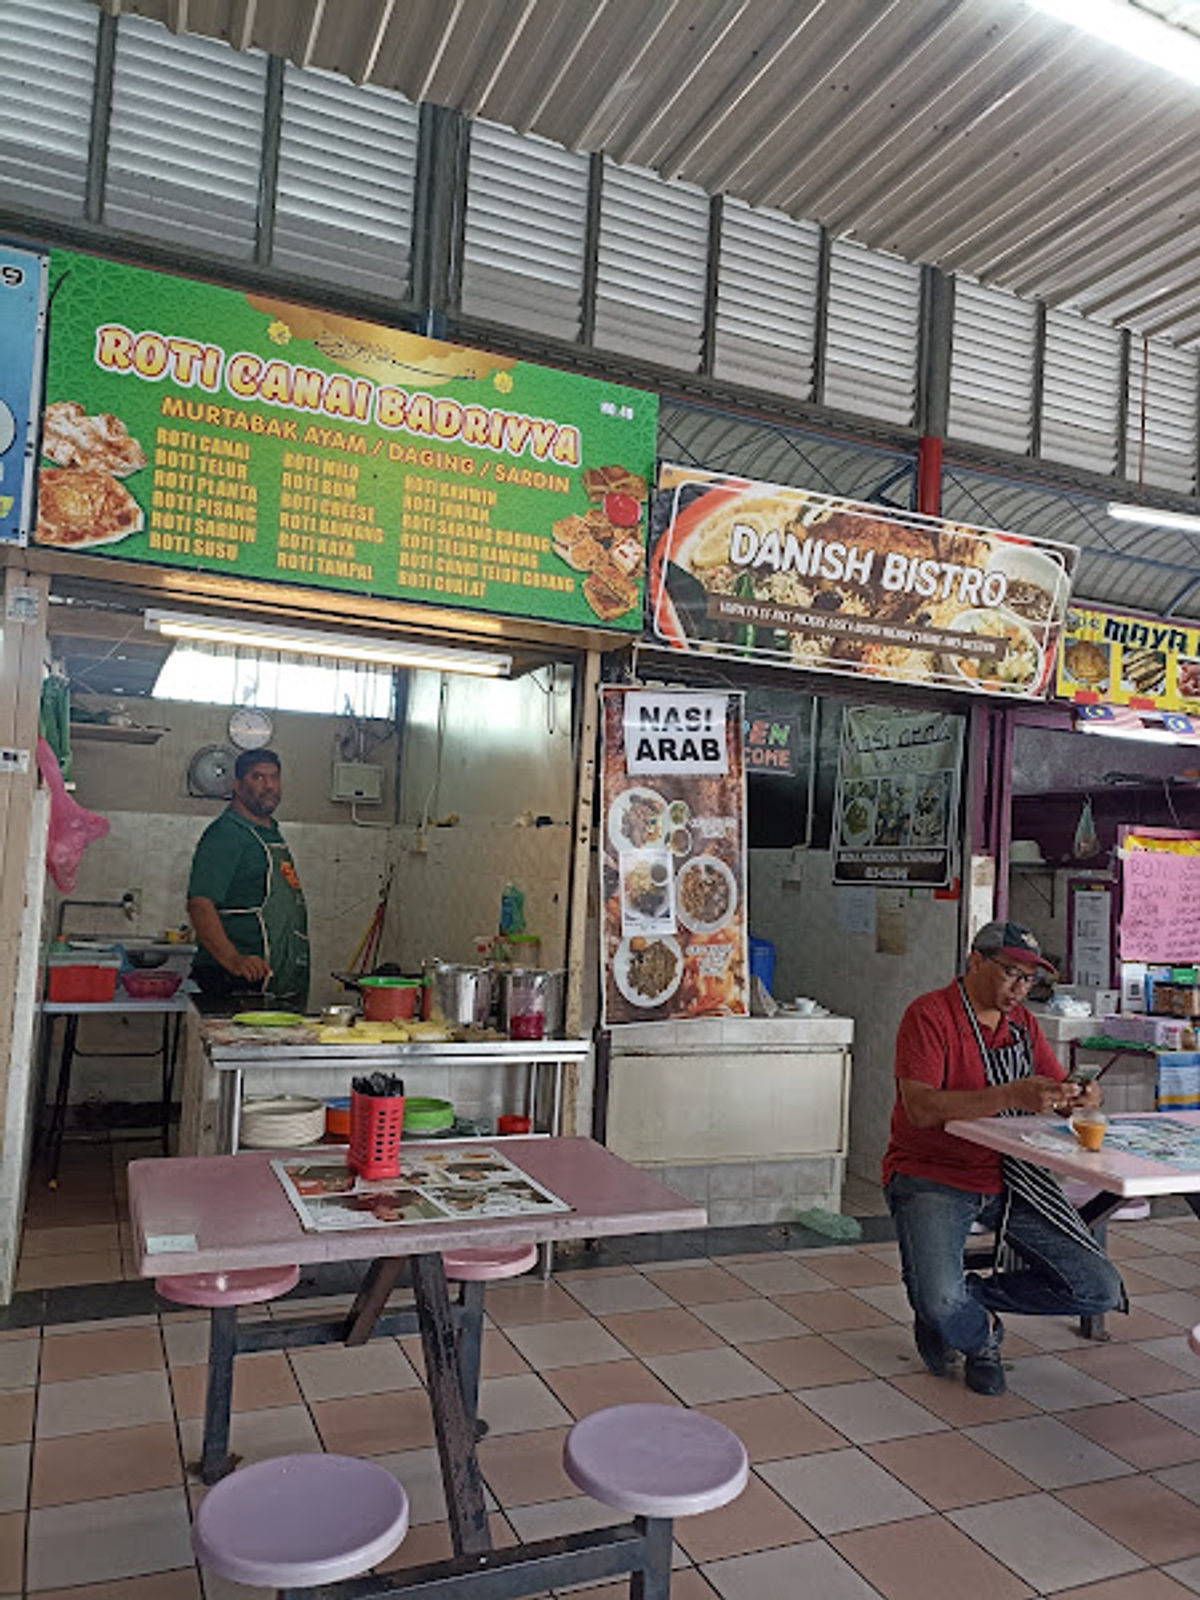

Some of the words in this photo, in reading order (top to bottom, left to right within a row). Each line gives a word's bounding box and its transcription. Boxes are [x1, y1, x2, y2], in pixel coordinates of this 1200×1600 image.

[96, 324, 224, 392] ROTI
[226, 353, 372, 423] CANAI
[156, 427, 196, 449] ROTI
[200, 435, 250, 460] CANAI
[162, 396, 299, 440] MURTABAK
[304, 426, 366, 454] AYAM
[388, 441, 475, 475] DAGING
[495, 463, 570, 494] SARDIN
[155, 448, 195, 471] ROTI
[199, 456, 247, 480] TELUR
[283, 451, 320, 473] ROTI
[154, 469, 194, 492] ROTI
[197, 477, 257, 503] PLANTA
[282, 472, 319, 492] ROTI
[404, 474, 436, 495] ROTI
[152, 490, 192, 513] ROTI
[195, 498, 257, 522] PISANG
[281, 492, 318, 513] ROTI
[403, 494, 436, 514] ROTI
[151, 510, 191, 532] ROTI
[194, 517, 257, 543] SARDIN
[279, 512, 316, 532] ROTI
[402, 513, 435, 532] ROTI
[149, 531, 190, 553] ROTI
[193, 538, 238, 561] SUSU
[278, 531, 315, 552] ROTI
[401, 532, 434, 550] ROTI
[277, 551, 314, 572] ROTI
[400, 551, 433, 570] ROTI
[730, 523, 875, 585] DANISH
[880, 552, 1007, 607] BISTRO
[398, 570, 432, 590] ROTI
[635, 738, 721, 761] ARAB
